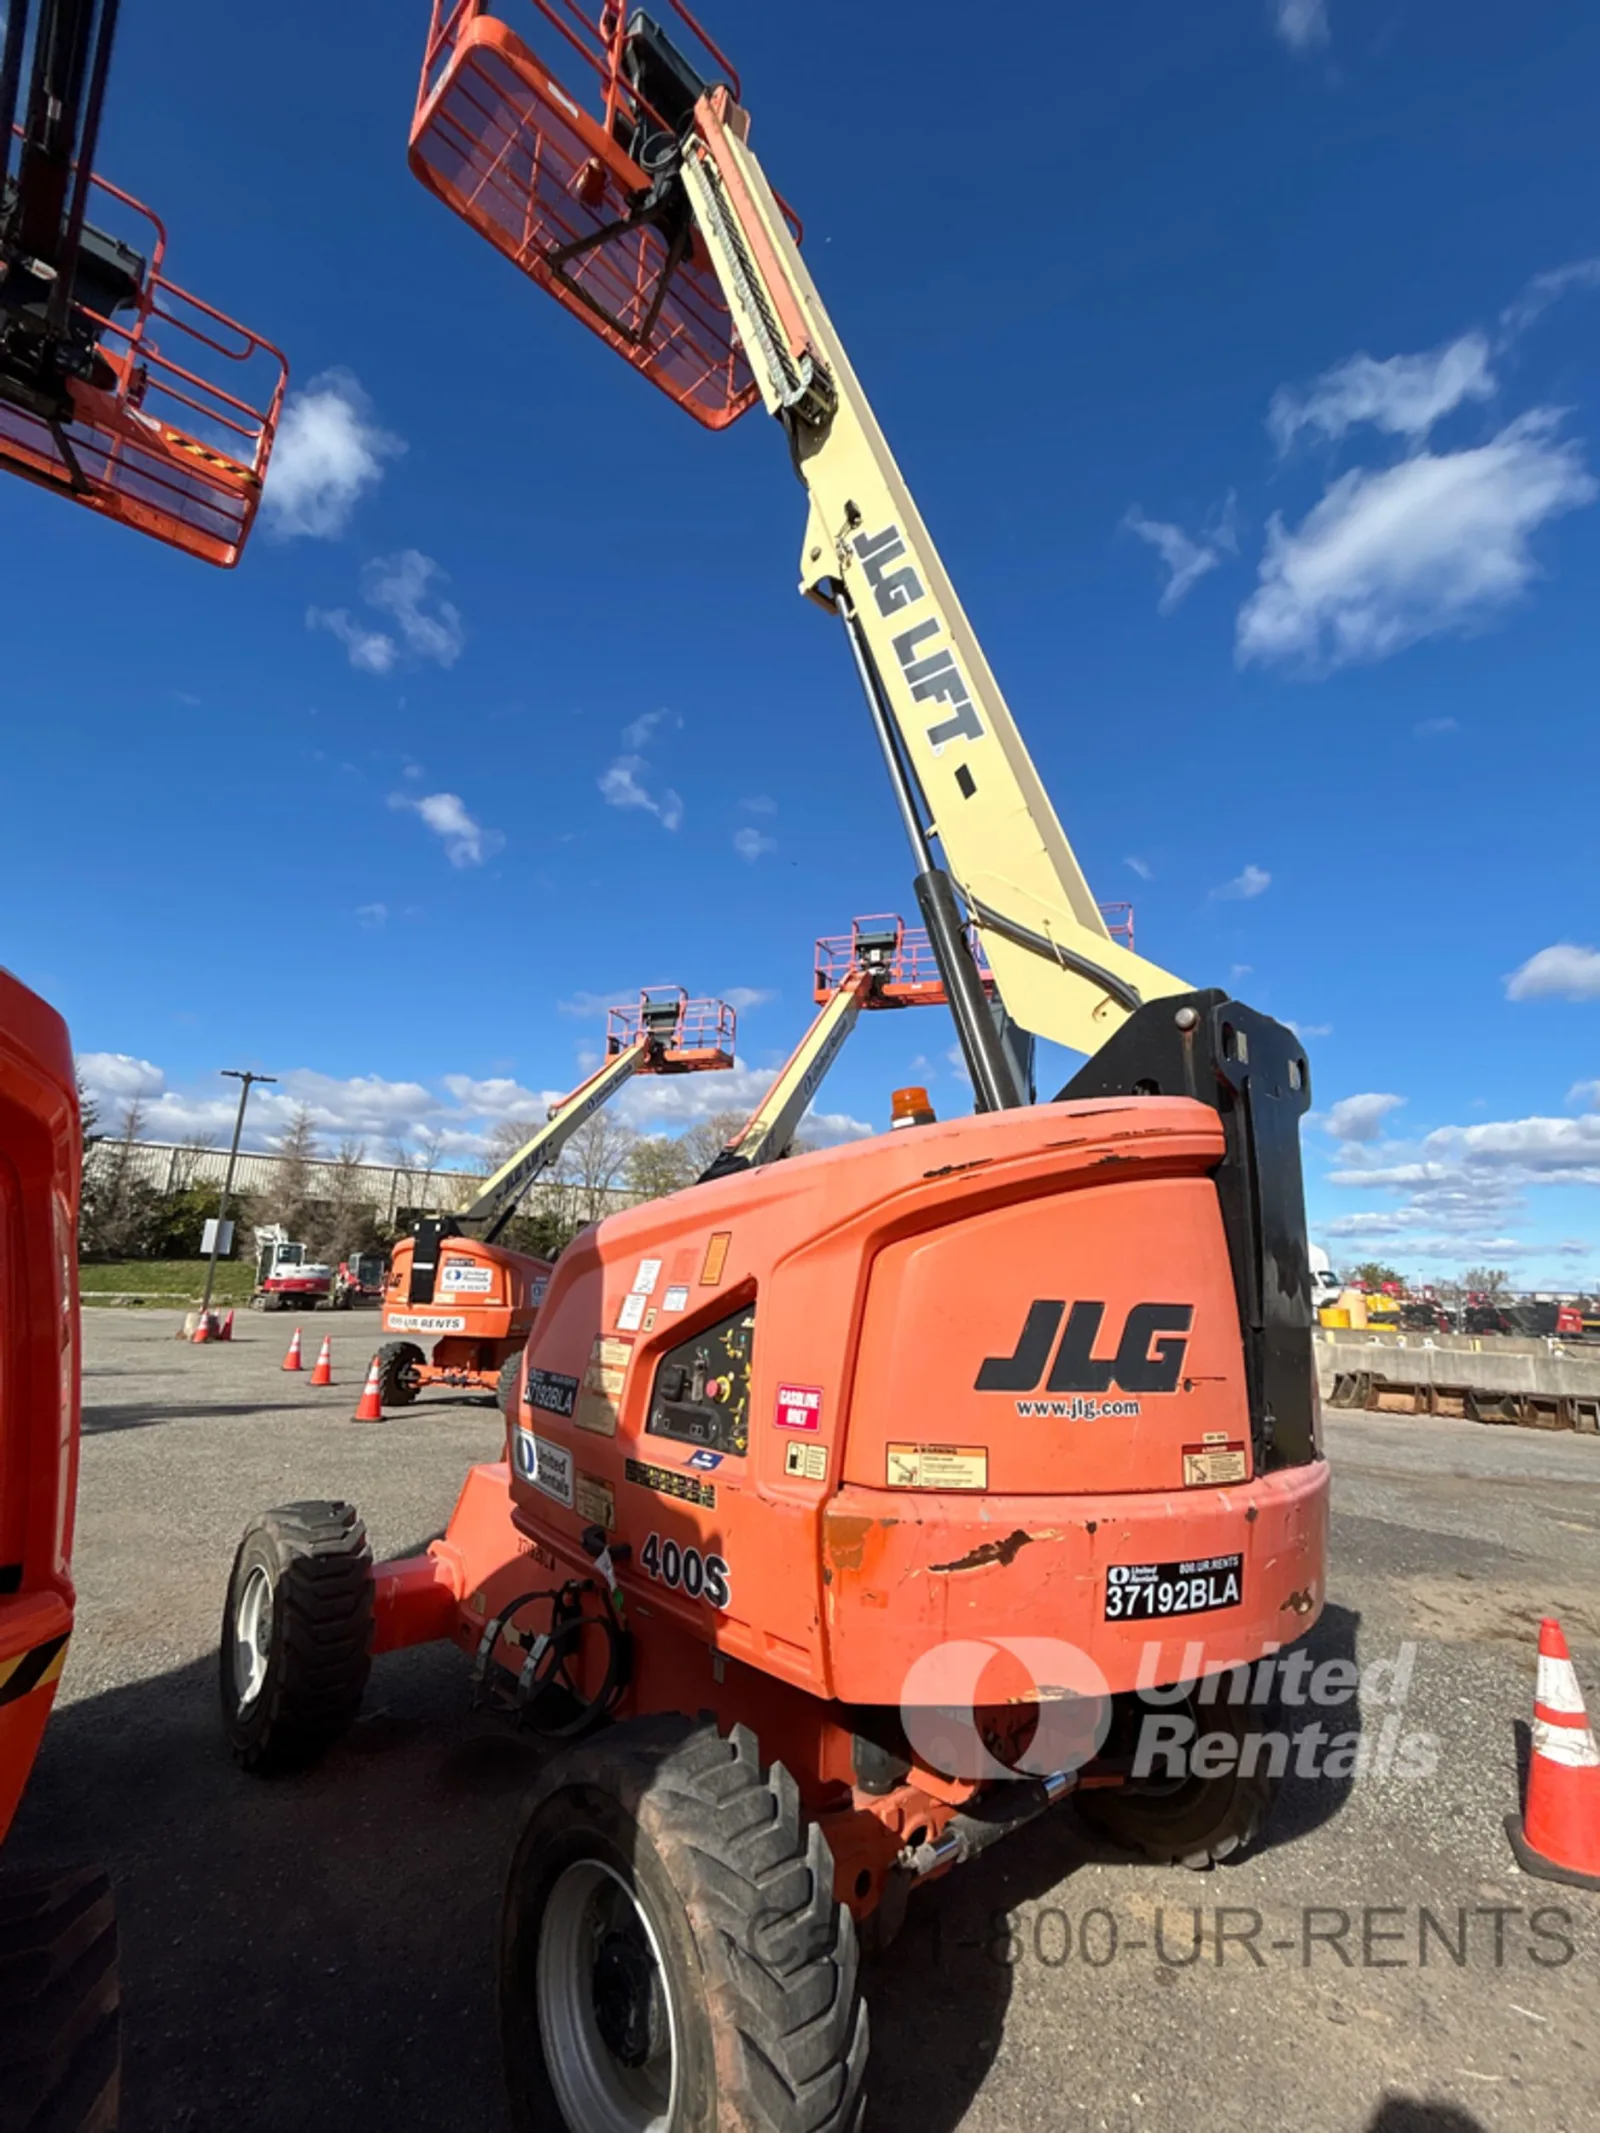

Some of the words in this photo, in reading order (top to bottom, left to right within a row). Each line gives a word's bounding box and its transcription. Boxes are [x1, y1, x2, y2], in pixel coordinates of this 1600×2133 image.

[852, 524, 926, 619] JLG
[890, 616, 986, 748] LIFT
[974, 1299, 1195, 1393] JLG
[1017, 1398, 1140, 1419] www.jlg.com
[640, 1533, 730, 1610] 400S
[1106, 1573, 1239, 1617] 37192BLA
